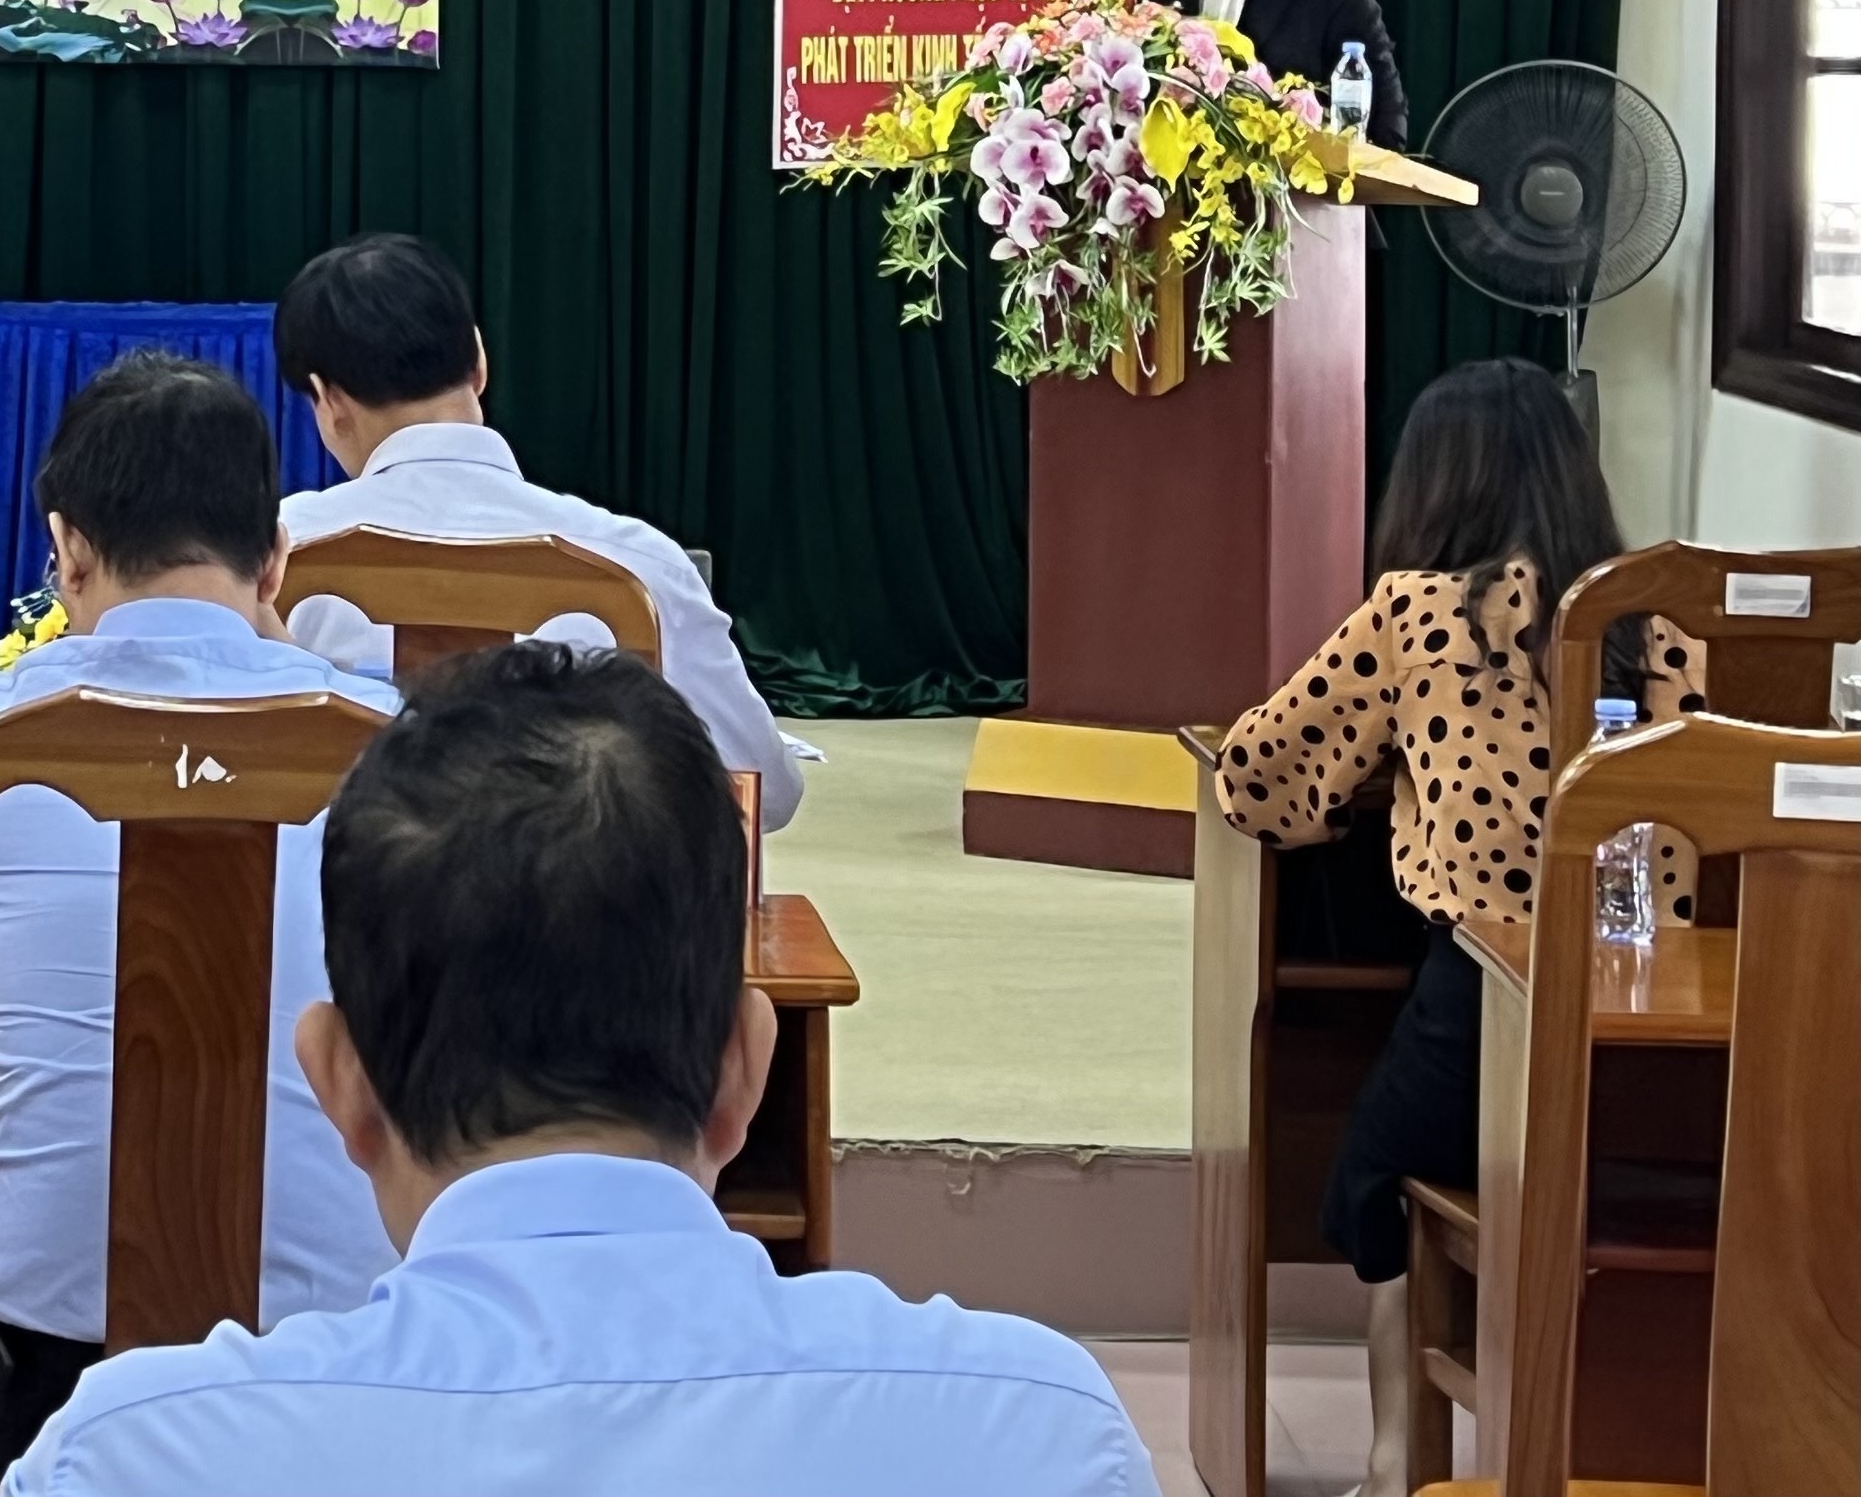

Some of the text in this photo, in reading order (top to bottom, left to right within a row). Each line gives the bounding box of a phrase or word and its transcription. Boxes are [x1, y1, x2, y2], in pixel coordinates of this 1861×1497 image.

[801, 25, 849, 84] PHÁT
[853, 15, 906, 83] TRIỂN
[912, 34, 958, 83] KINH
